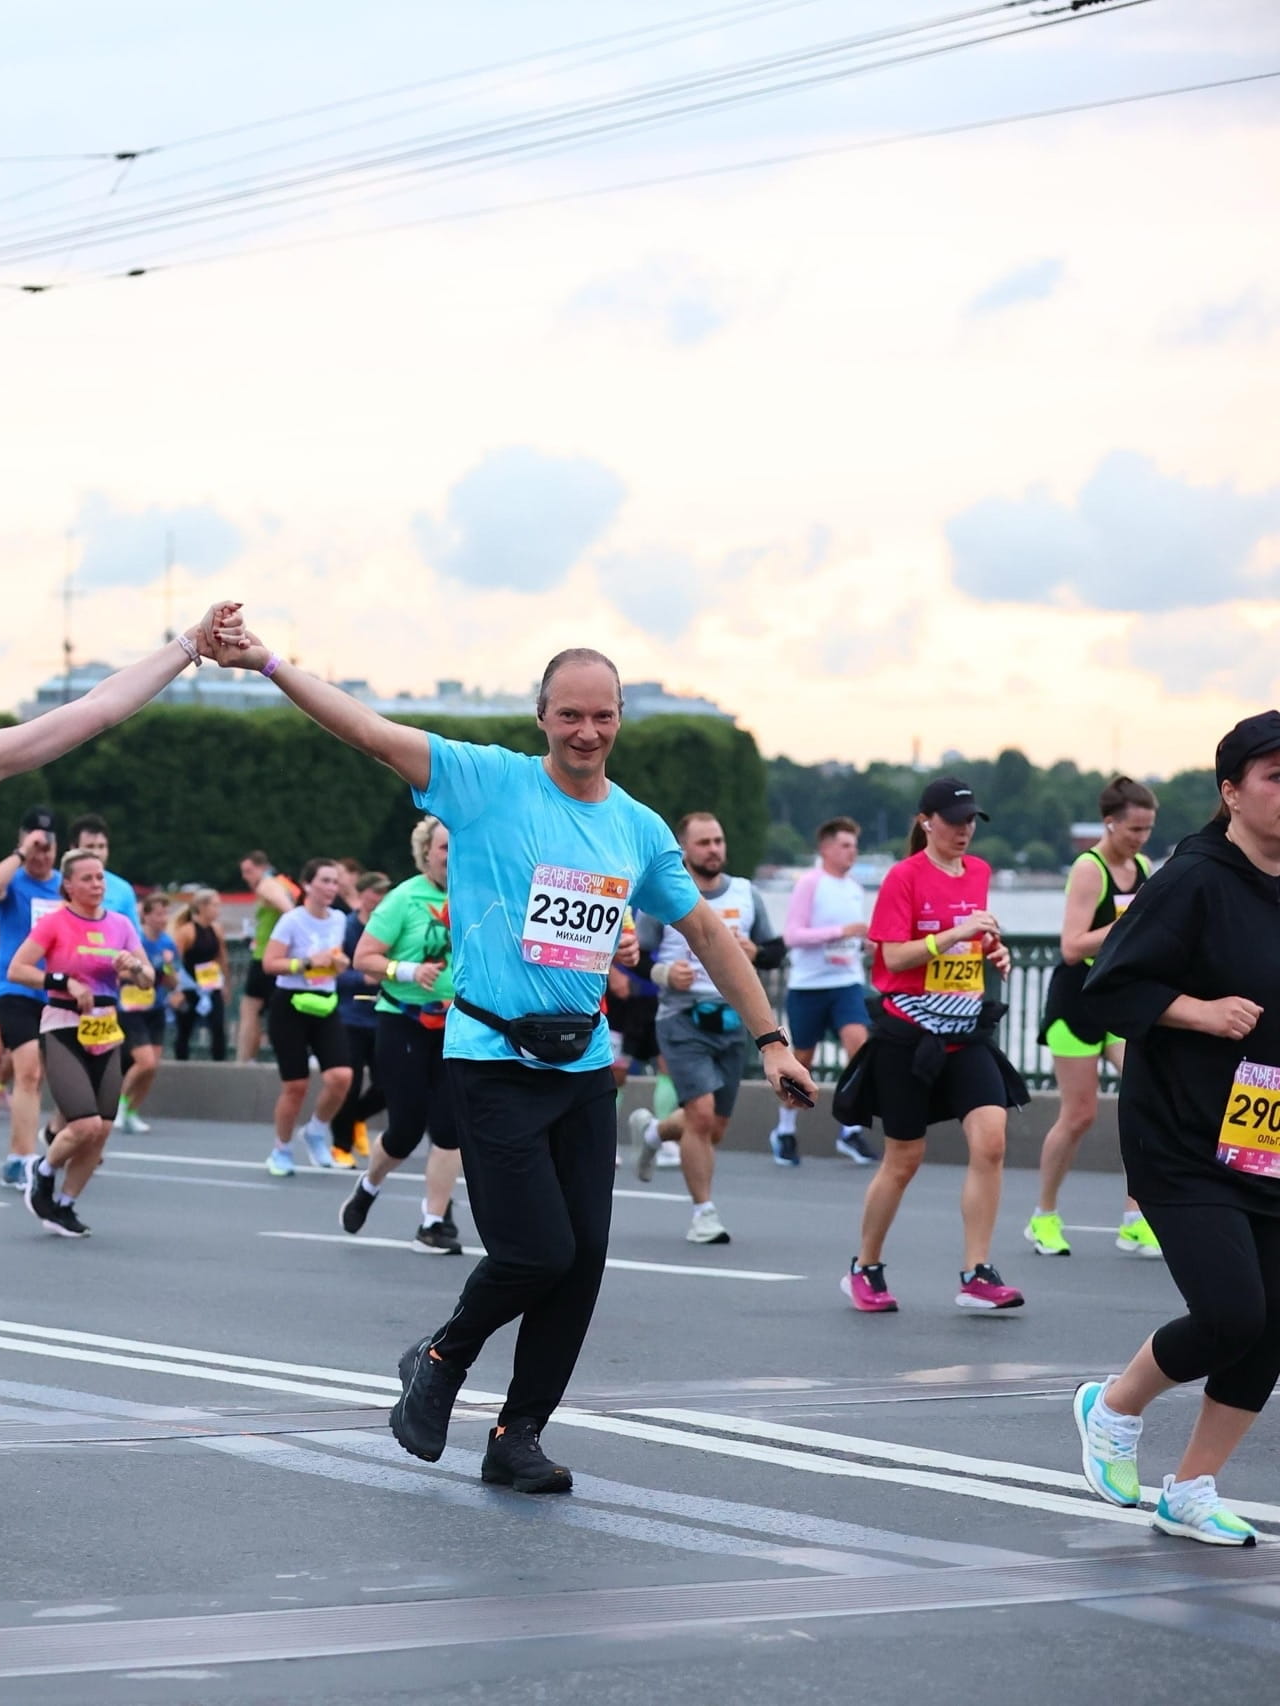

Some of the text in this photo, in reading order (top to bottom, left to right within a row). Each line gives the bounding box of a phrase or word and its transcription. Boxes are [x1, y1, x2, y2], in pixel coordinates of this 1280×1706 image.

[571, 872, 605, 888] НОЧИ
[530, 893, 620, 935] 23309
[555, 930, 592, 945] МИХАИЛ
[931, 960, 982, 981] 17257
[1257, 1134, 1280, 1146] ОЛЬГ
[1225, 1147, 1240, 1165] F
